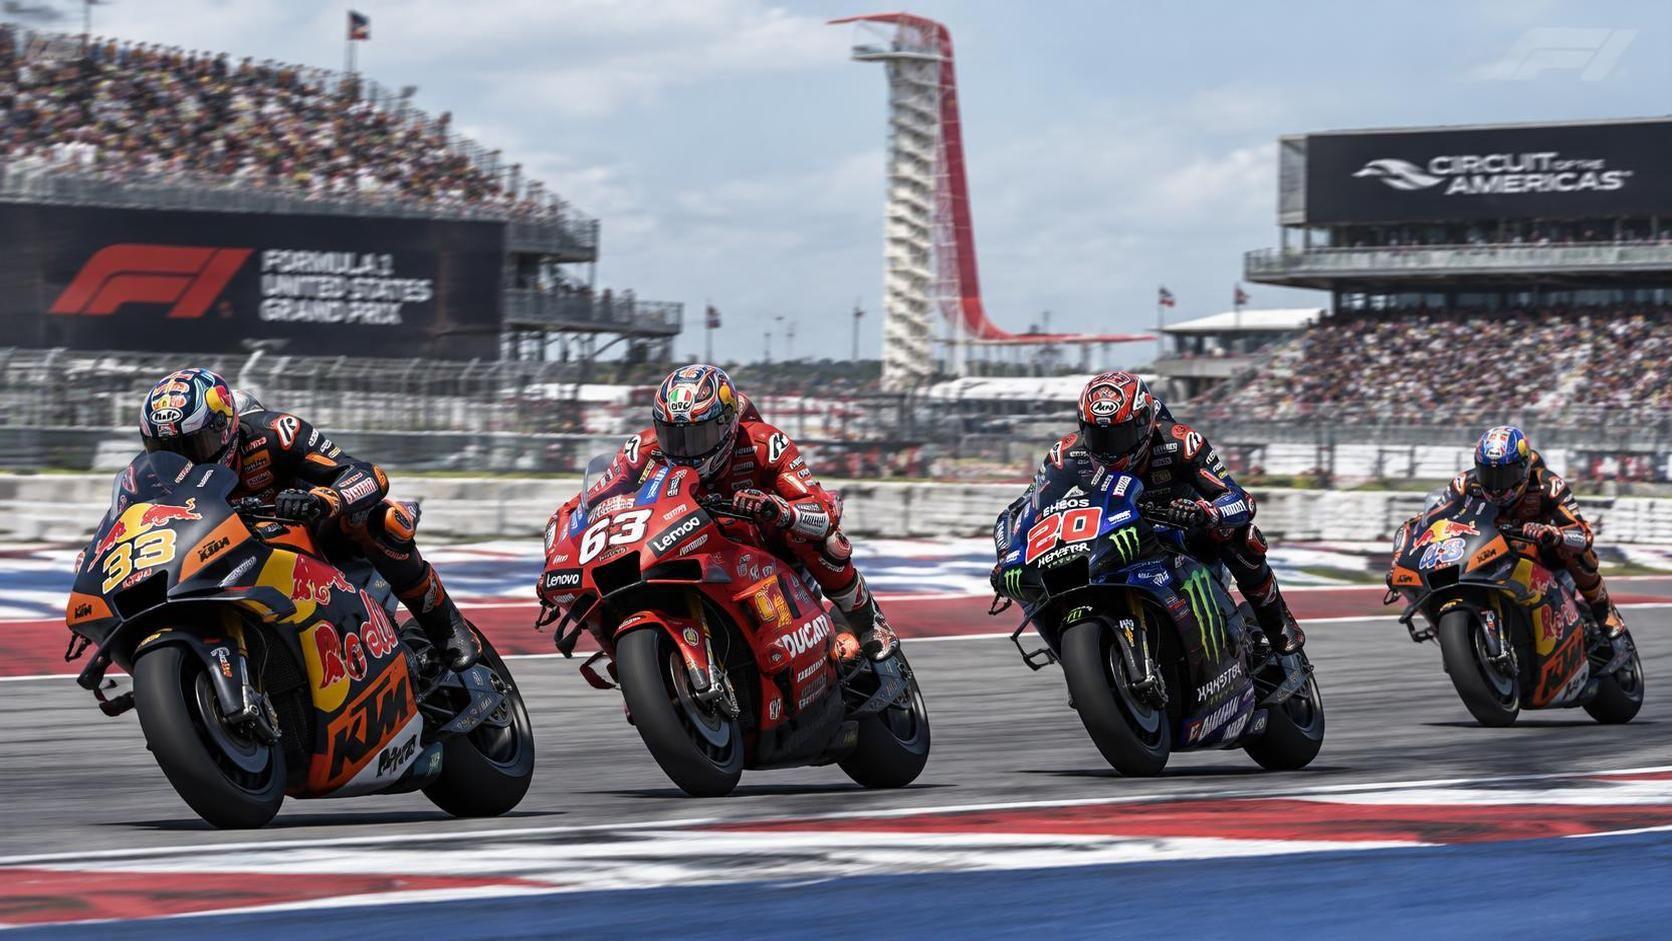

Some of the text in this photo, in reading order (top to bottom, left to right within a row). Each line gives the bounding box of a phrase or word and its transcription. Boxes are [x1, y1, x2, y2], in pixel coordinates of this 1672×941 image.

[1428, 152, 1559, 174] CIRCUIT
[1444, 171, 1627, 195] AMERICAS
[260, 249, 395, 276] FORMULA 1
[48, 243, 256, 319] F1
[259, 274, 433, 303] UNITED STATES
[259, 298, 404, 325] GRAND PRIX
[578, 509, 653, 566] 63
[1024, 506, 1103, 566] 20
[101, 528, 177, 595] 33
[546, 573, 580, 588] Lenovo
[328, 674, 408, 780] KTM
